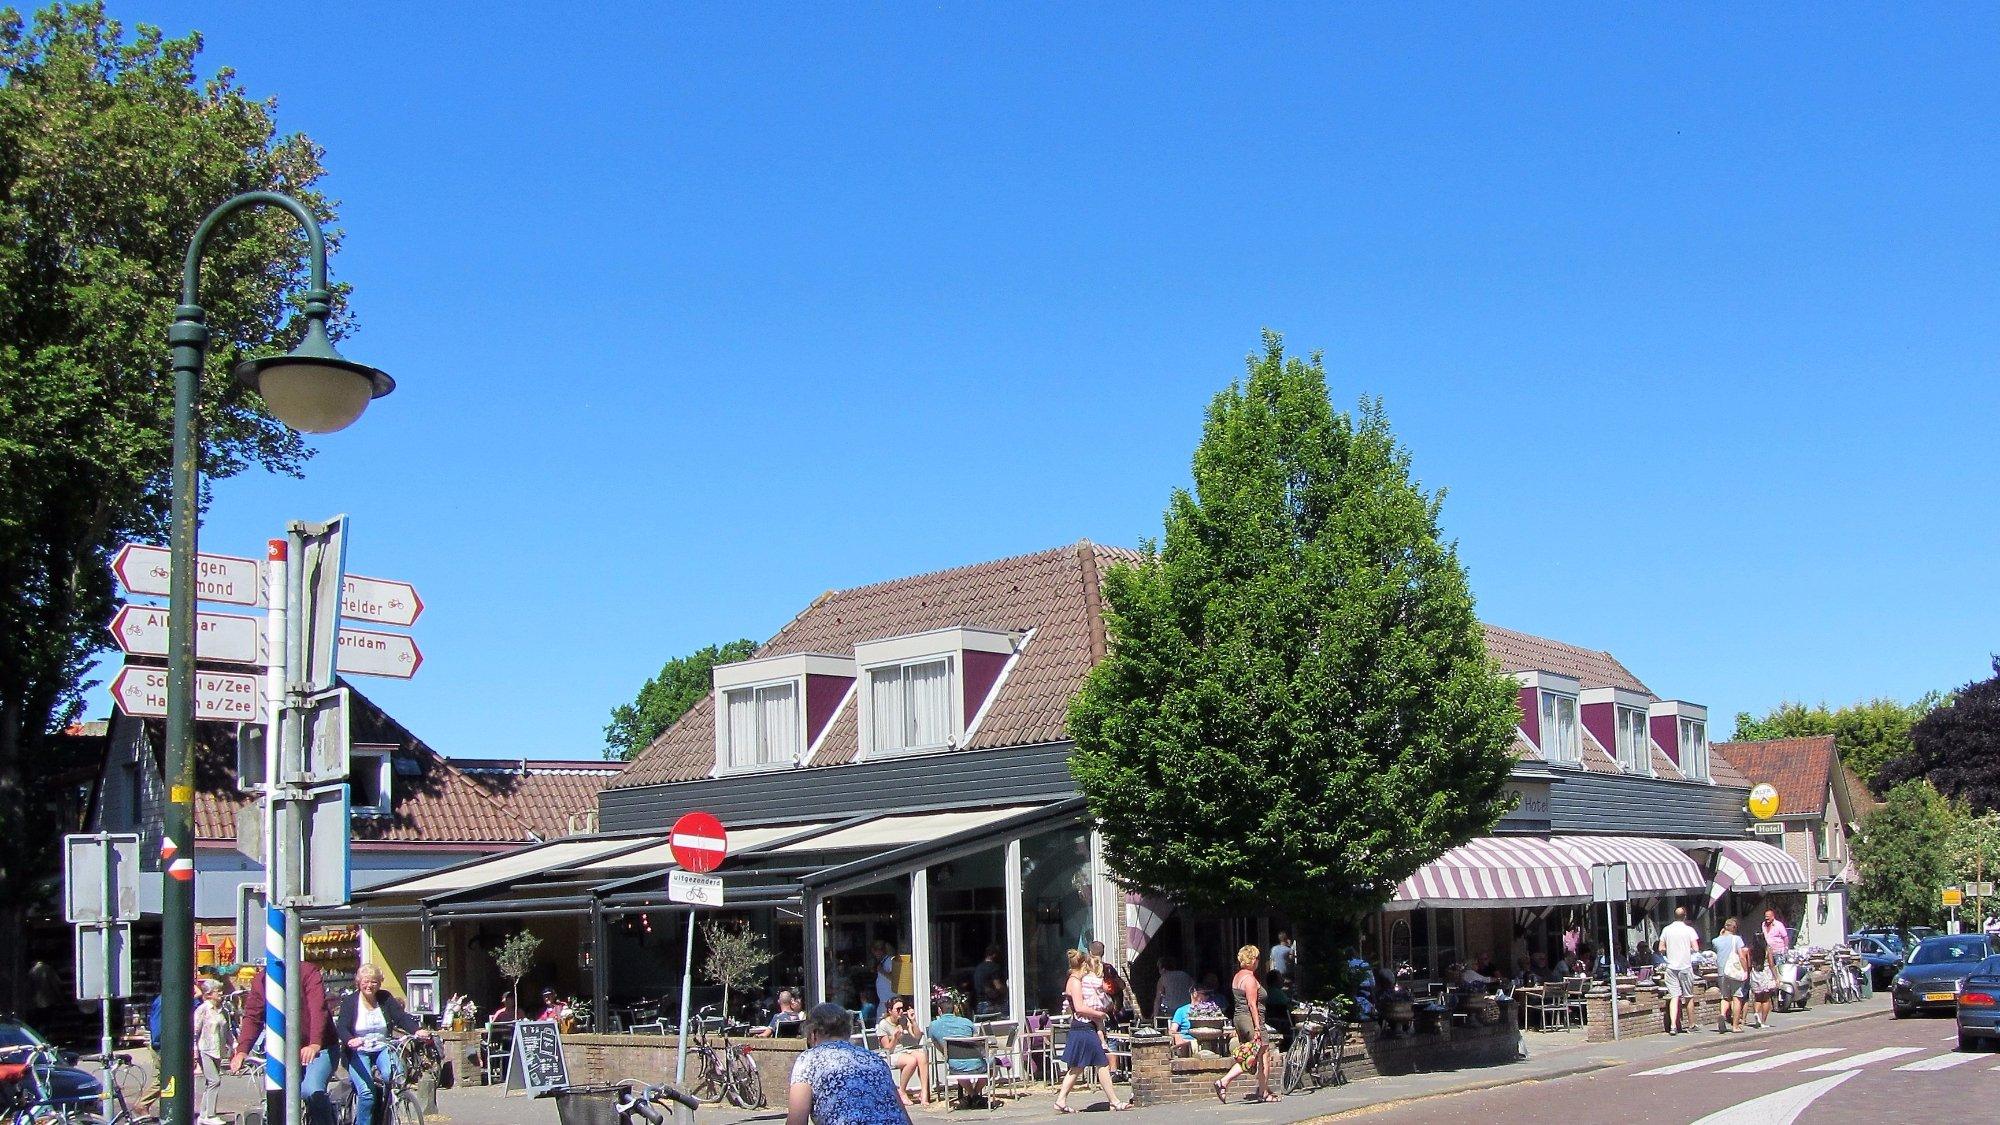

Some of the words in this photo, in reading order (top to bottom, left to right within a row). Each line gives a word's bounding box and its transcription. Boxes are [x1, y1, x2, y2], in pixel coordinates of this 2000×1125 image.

[207, 679, 251, 693] a/Zee
[206, 697, 251, 712] a/Zee
[1525, 797, 1549, 813] Hotel
[1758, 825, 1780, 833] Hotel
[673, 874, 721, 886] uitgezonderd
